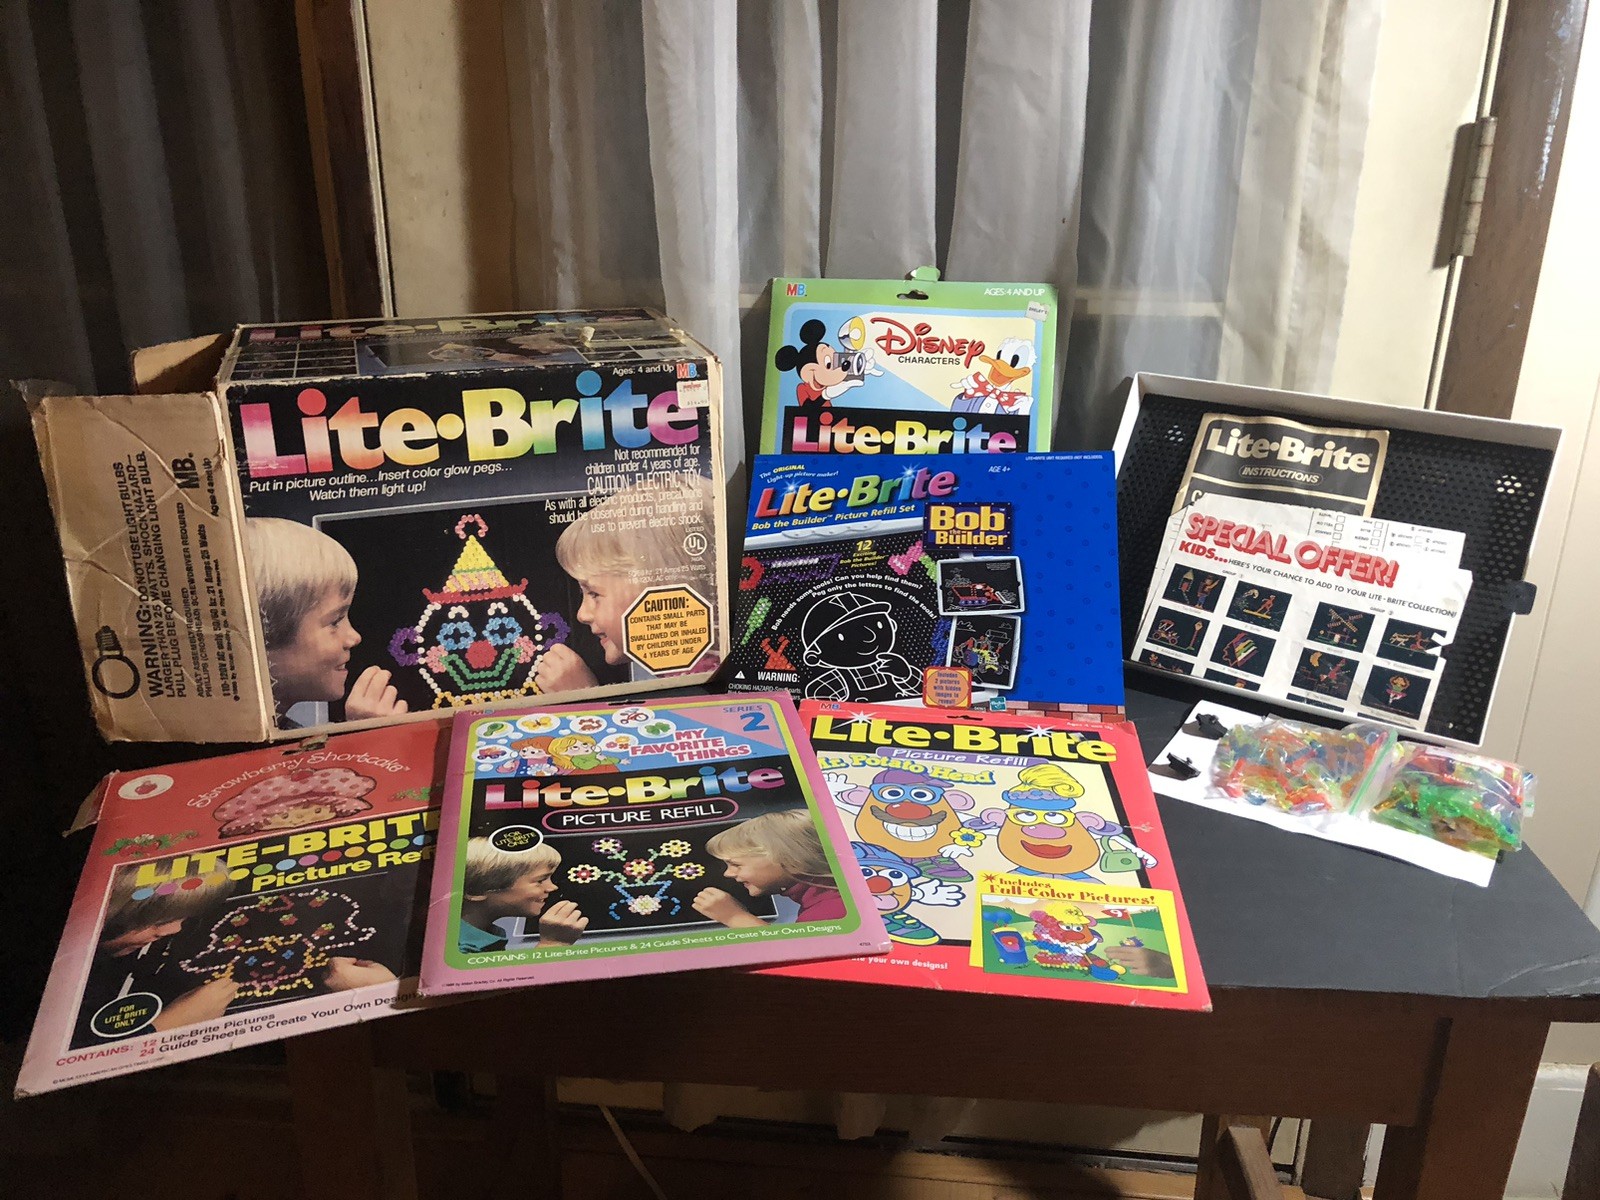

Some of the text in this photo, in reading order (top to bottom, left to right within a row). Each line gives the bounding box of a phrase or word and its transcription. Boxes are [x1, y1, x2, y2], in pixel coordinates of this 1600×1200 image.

[898, 355, 961, 366] CHARACTERS
[612, 365, 675, 377] Ages: 4 and Up
[676, 363, 698, 379] MB
[614, 444, 700, 461] Not recommended for
[585, 457, 700, 477] children under 4 years of age.
[1242, 466, 1320, 484] INSTRUCTIONS
[250, 481, 270, 493] Put
[273, 479, 284, 491] in
[286, 476, 327, 493] picture
[412, 468, 441, 481] color
[444, 465, 471, 477] glow
[473, 463, 513, 476] pegs...
[587, 468, 702, 497] CAUTION: ELECTRIC TOY
[310, 481, 426, 501] Watch them light up!
[751, 522, 771, 531] Bob
[773, 519, 789, 528] the
[834, 511, 869, 521] Picture
[871, 506, 897, 517] Refill
[899, 504, 916, 513] Set
[929, 505, 1005, 531] Bob
[138, 516, 152, 556] SHOCK
[856, 540, 873, 551] 12
[935, 531, 1008, 546] Builder
[1185, 512, 1400, 588] SPECIAL OFFER!
[113, 462, 163, 697] WARNING: DO NOT USE LIGHT BULBS
[136, 451, 186, 697] PULL PLUG BEFORE CHANGING LIGHT BULB.
[146, 559, 160, 601] WATTS.
[1179, 540, 1228, 563] KIDS...
[1228, 558, 1250, 570] HERE'S
[1252, 564, 1272, 575] YOUR
[1273, 570, 1303, 583] CHANCE
[1304, 577, 1315, 585] TO
[1316, 581, 1333, 590] ADD
[1334, 584, 1345, 593] TO
[1346, 587, 1367, 598] YOUR
[1407, 601, 1457, 618] COLLECTION!
[152, 604, 162, 618] 25
[644, 597, 690, 613] CAUTION:
[630, 609, 706, 624] CONTAINS SMALL PARTS
[646, 620, 688, 632] THAT MAY BE
[154, 621, 167, 650] THAN
[630, 627, 707, 643] SWALLOWED OR INHALED
[647, 640, 678, 650] CHILDREN
[680, 637, 702, 646] UNDER
[161, 653, 175, 697] LARGER
[757, 671, 800, 683] WARNING:
[722, 704, 763, 713] SERIES
[740, 711, 770, 733] 2
[674, 728, 707, 742] MY
[630, 737, 724, 757] FAVORITE
[674, 745, 751, 763] THINGS
[892, 748, 1029, 767] Picture Refill
[849, 754, 924, 775] Potato
[929, 764, 996, 785] Head
[187, 752, 405, 809] Strawberry Shortcake
[562, 803, 723, 827] PICTURE REFILL
[251, 858, 372, 892] Picture
[999, 878, 1051, 889] Includes
[990, 884, 1155, 905] Full-Color Pictures!
[1111, 908, 1123, 918] 9
[467, 953, 529, 965] CONTAINS:
[532, 951, 542, 960] 12
[545, 947, 589, 958] Lite-Brite
[590, 943, 628, 954] Pictures
[640, 941, 651, 949] 24
[653, 937, 681, 948] Guide
[682, 935, 713, 945] Sheets
[727, 931, 759, 941] Create
[759, 928, 780, 937] Your
[781, 926, 806, 936] Own
[807, 924, 842, 935] Designs
[868, 956, 949, 971] your own designs!
[104, 1008, 148, 1025] LITE BRITE
[119, 1004, 135, 1013] FOR
[114, 1019, 136, 1029] ONLY
[140, 992, 418, 1058] 24 Guide Sheets to Create Your Own Design
[56, 1012, 276, 1067] CONTAINS: 12 Lite-Brite Pictures
